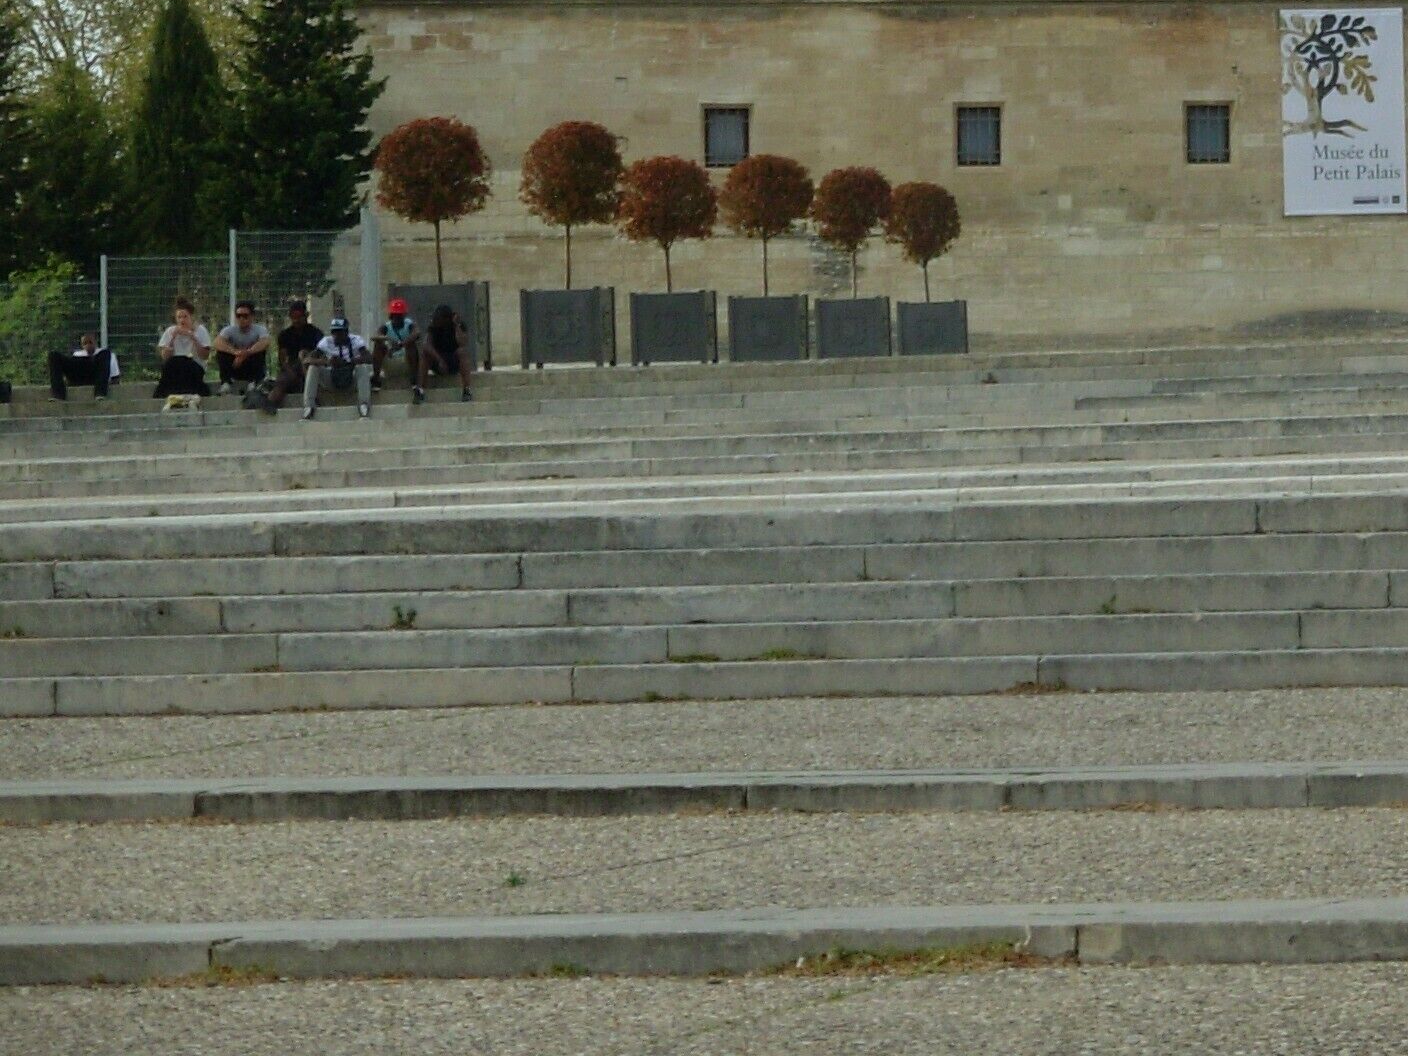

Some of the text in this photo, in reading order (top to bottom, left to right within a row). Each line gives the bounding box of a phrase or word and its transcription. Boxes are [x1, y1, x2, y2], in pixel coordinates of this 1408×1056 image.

[1313, 144, 1389, 160] Musée du
[1313, 164, 1401, 181] Petit Palais
